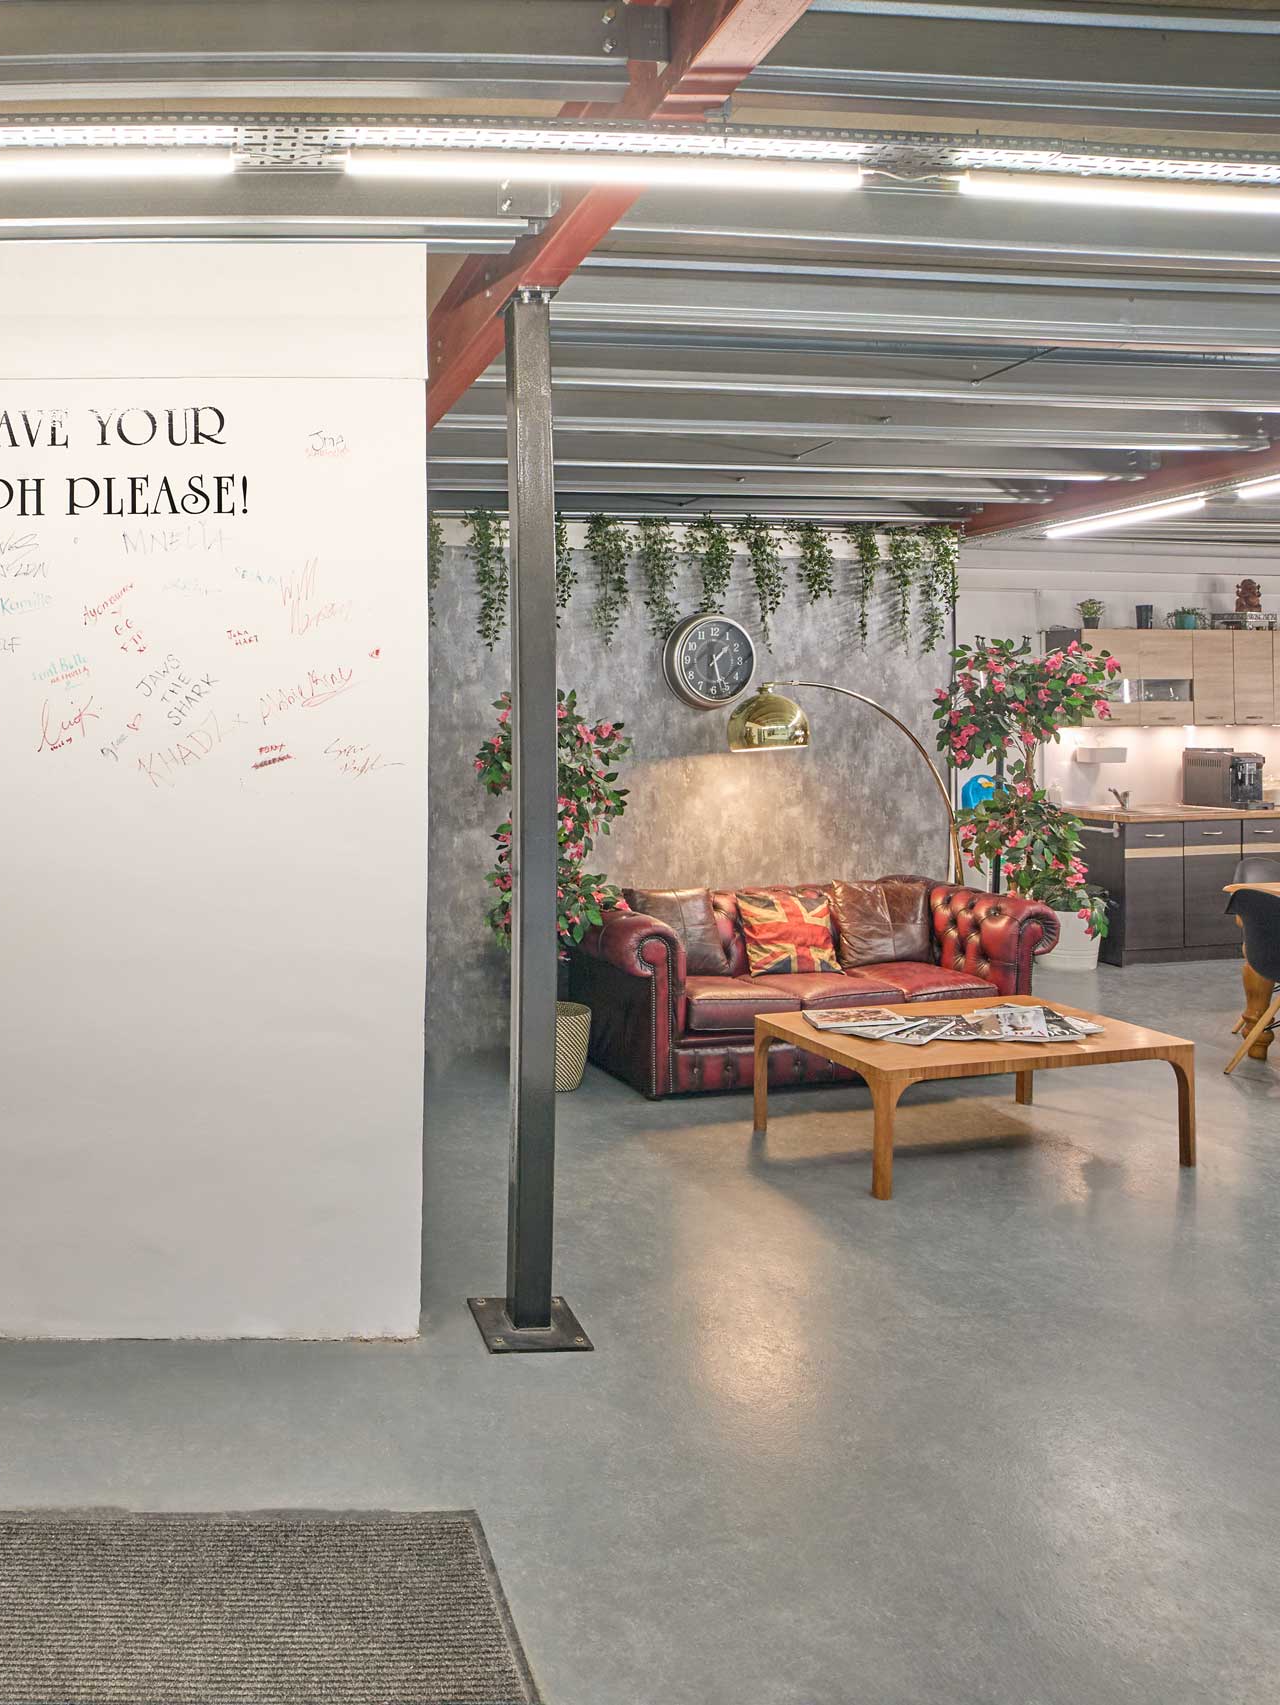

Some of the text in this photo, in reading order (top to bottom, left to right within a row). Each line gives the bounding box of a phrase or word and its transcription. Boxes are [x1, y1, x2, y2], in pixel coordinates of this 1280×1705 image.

[88, 406, 227, 446] YOUR
[65, 474, 248, 517] PLEASE!
[698, 631, 705, 640] 11
[710, 627, 720, 636] 12
[725, 631, 730, 640] 1
[688, 641, 697, 651] 10
[733, 643, 739, 653] 2
[684, 656, 691, 664] 9
[737, 656, 743, 665] 3
[136, 654, 181, 697] JAWS
[688, 670, 695, 680] 8
[733, 671, 739, 681] 4
[160, 672, 192, 704] THE
[697, 681, 704, 691] 7
[710, 685, 716, 695] 6
[724, 682, 730, 692] 5
[167, 673, 219, 726] SHARK
